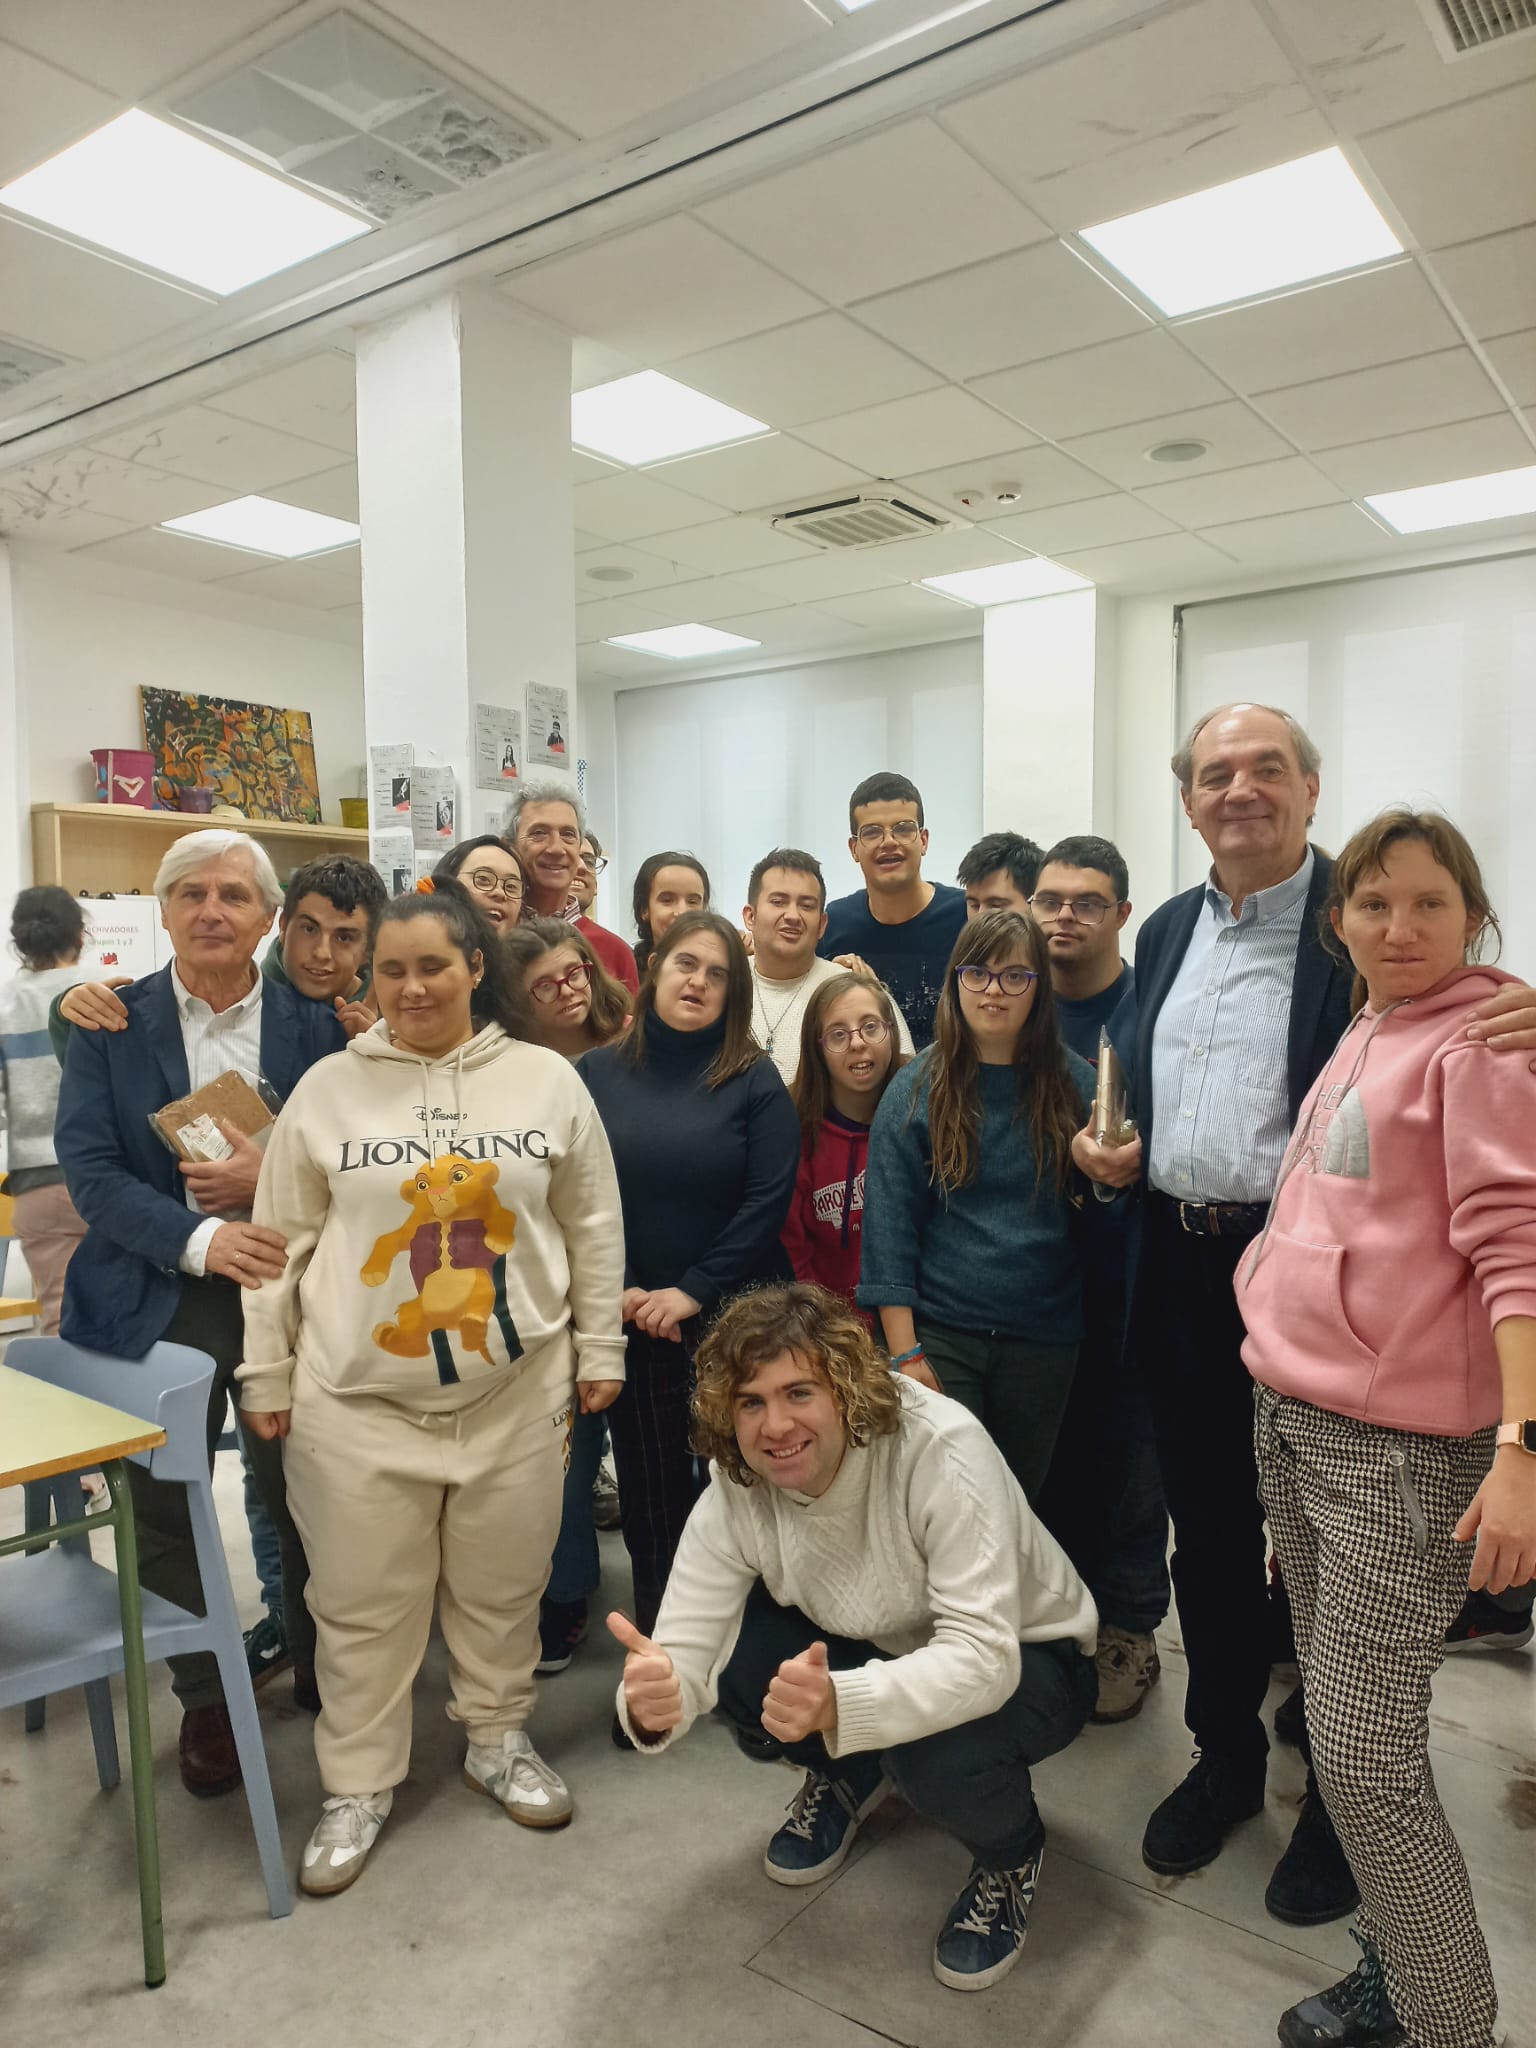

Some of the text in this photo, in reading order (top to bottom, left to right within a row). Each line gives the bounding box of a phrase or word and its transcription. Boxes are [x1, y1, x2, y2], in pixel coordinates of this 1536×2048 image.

[421, 1128, 459, 1138] THE
[337, 1129, 550, 1172] LION KING
